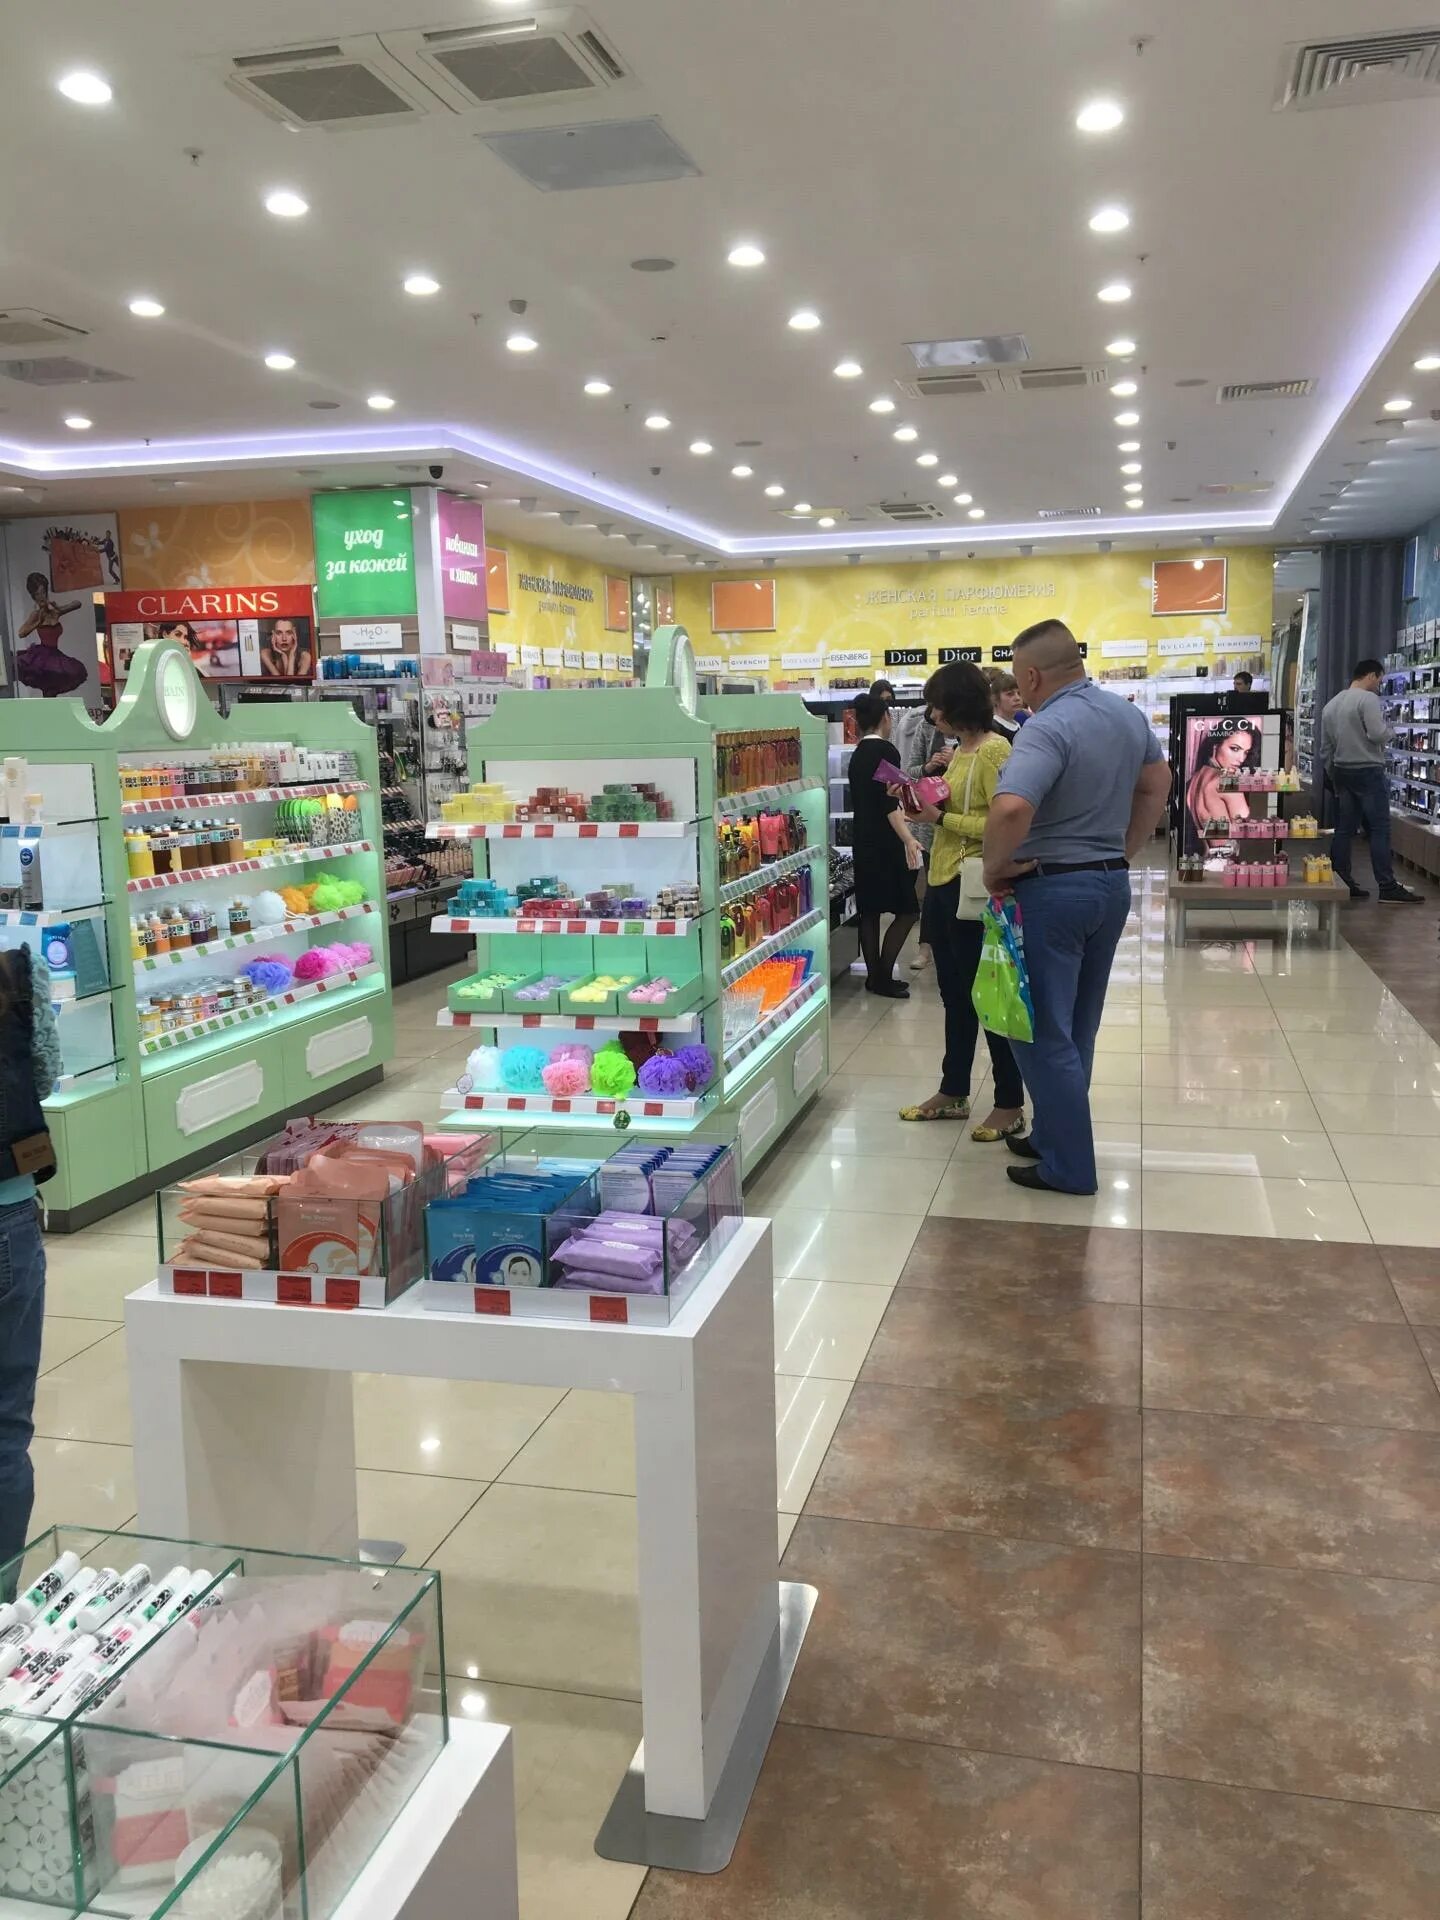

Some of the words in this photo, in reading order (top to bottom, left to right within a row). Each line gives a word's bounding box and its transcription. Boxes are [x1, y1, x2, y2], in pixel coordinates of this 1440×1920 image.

[344, 529, 384, 550] уход
[325, 560, 346, 581] за
[350, 552, 408, 573] кожей
[866, 588, 936, 604] ЖЕНСКАЯ
[944, 583, 1056, 601] ПАРФЮМЕРИЯ
[137, 592, 279, 616] CLARINS
[910, 605, 956, 619] parfum
[963, 604, 1007, 617] femme
[1160, 642, 1203, 650] BVLGARI
[830, 653, 869, 662] EISENBERG
[890, 651, 922, 665] Dior
[943, 649, 977, 662] Dior
[1194, 719, 1256, 731] GUCCI
